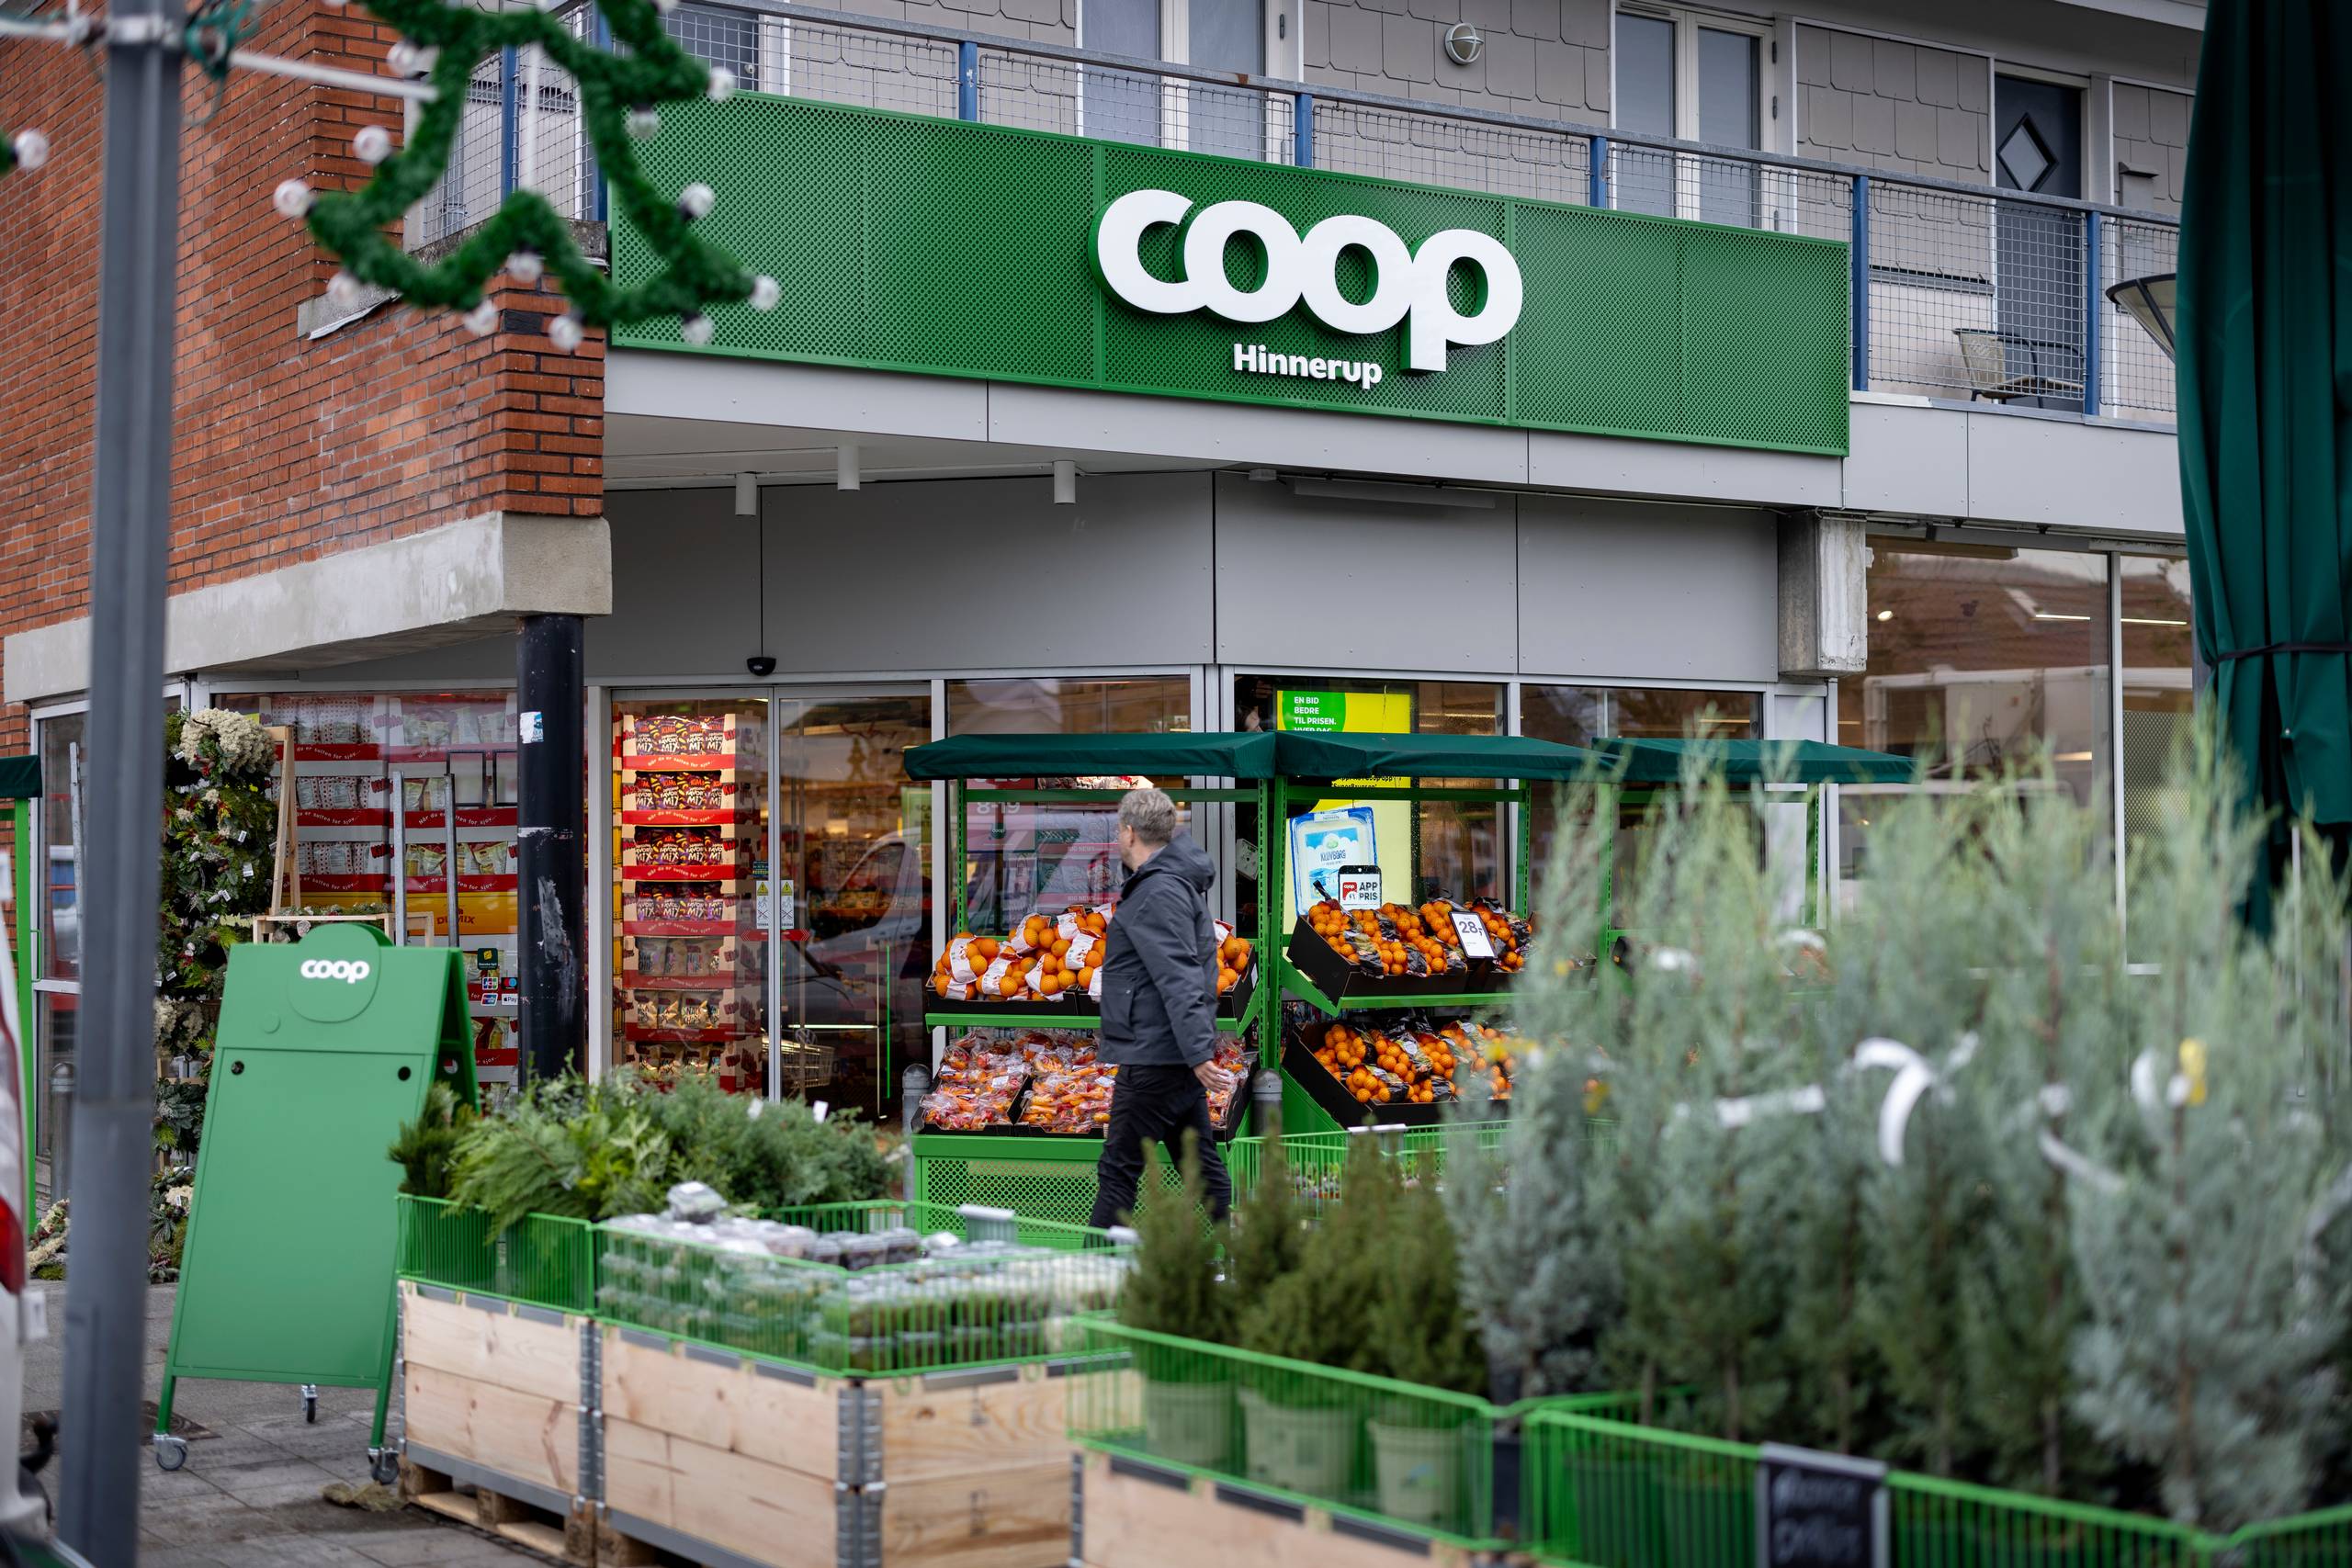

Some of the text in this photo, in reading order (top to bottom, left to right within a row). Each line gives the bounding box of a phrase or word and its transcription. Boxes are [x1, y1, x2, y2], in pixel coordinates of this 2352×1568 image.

[1097, 189, 1522, 371] coop
[1234, 344, 1383, 389] Hinnerup
[1294, 706, 1319, 715] BEDRE
[1359, 882, 1378, 891] APP
[1359, 892, 1378, 901] PRIS
[300, 959, 370, 984] coop
